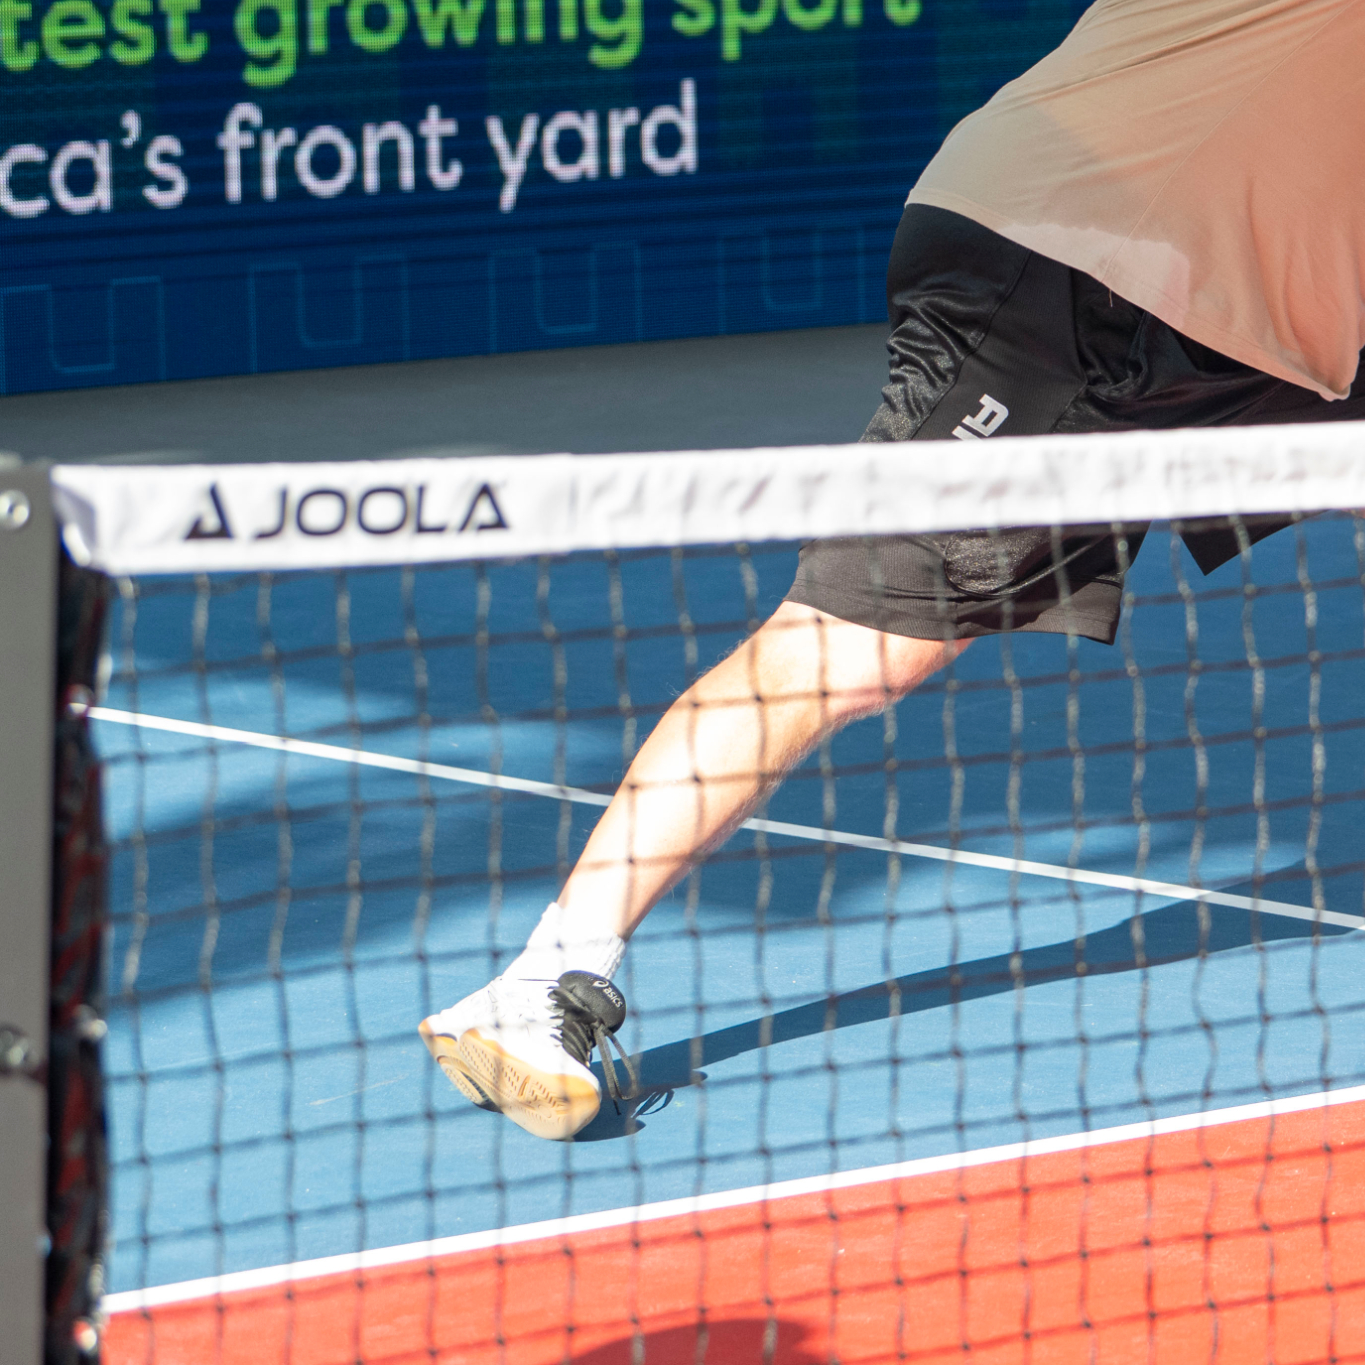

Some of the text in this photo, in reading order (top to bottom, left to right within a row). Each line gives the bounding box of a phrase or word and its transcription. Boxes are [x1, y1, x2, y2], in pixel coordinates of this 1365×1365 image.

[217, 102, 462, 204] front
[486, 78, 699, 213] yard
[255, 481, 510, 541] JOOLA
[603, 987, 623, 1008] asics
